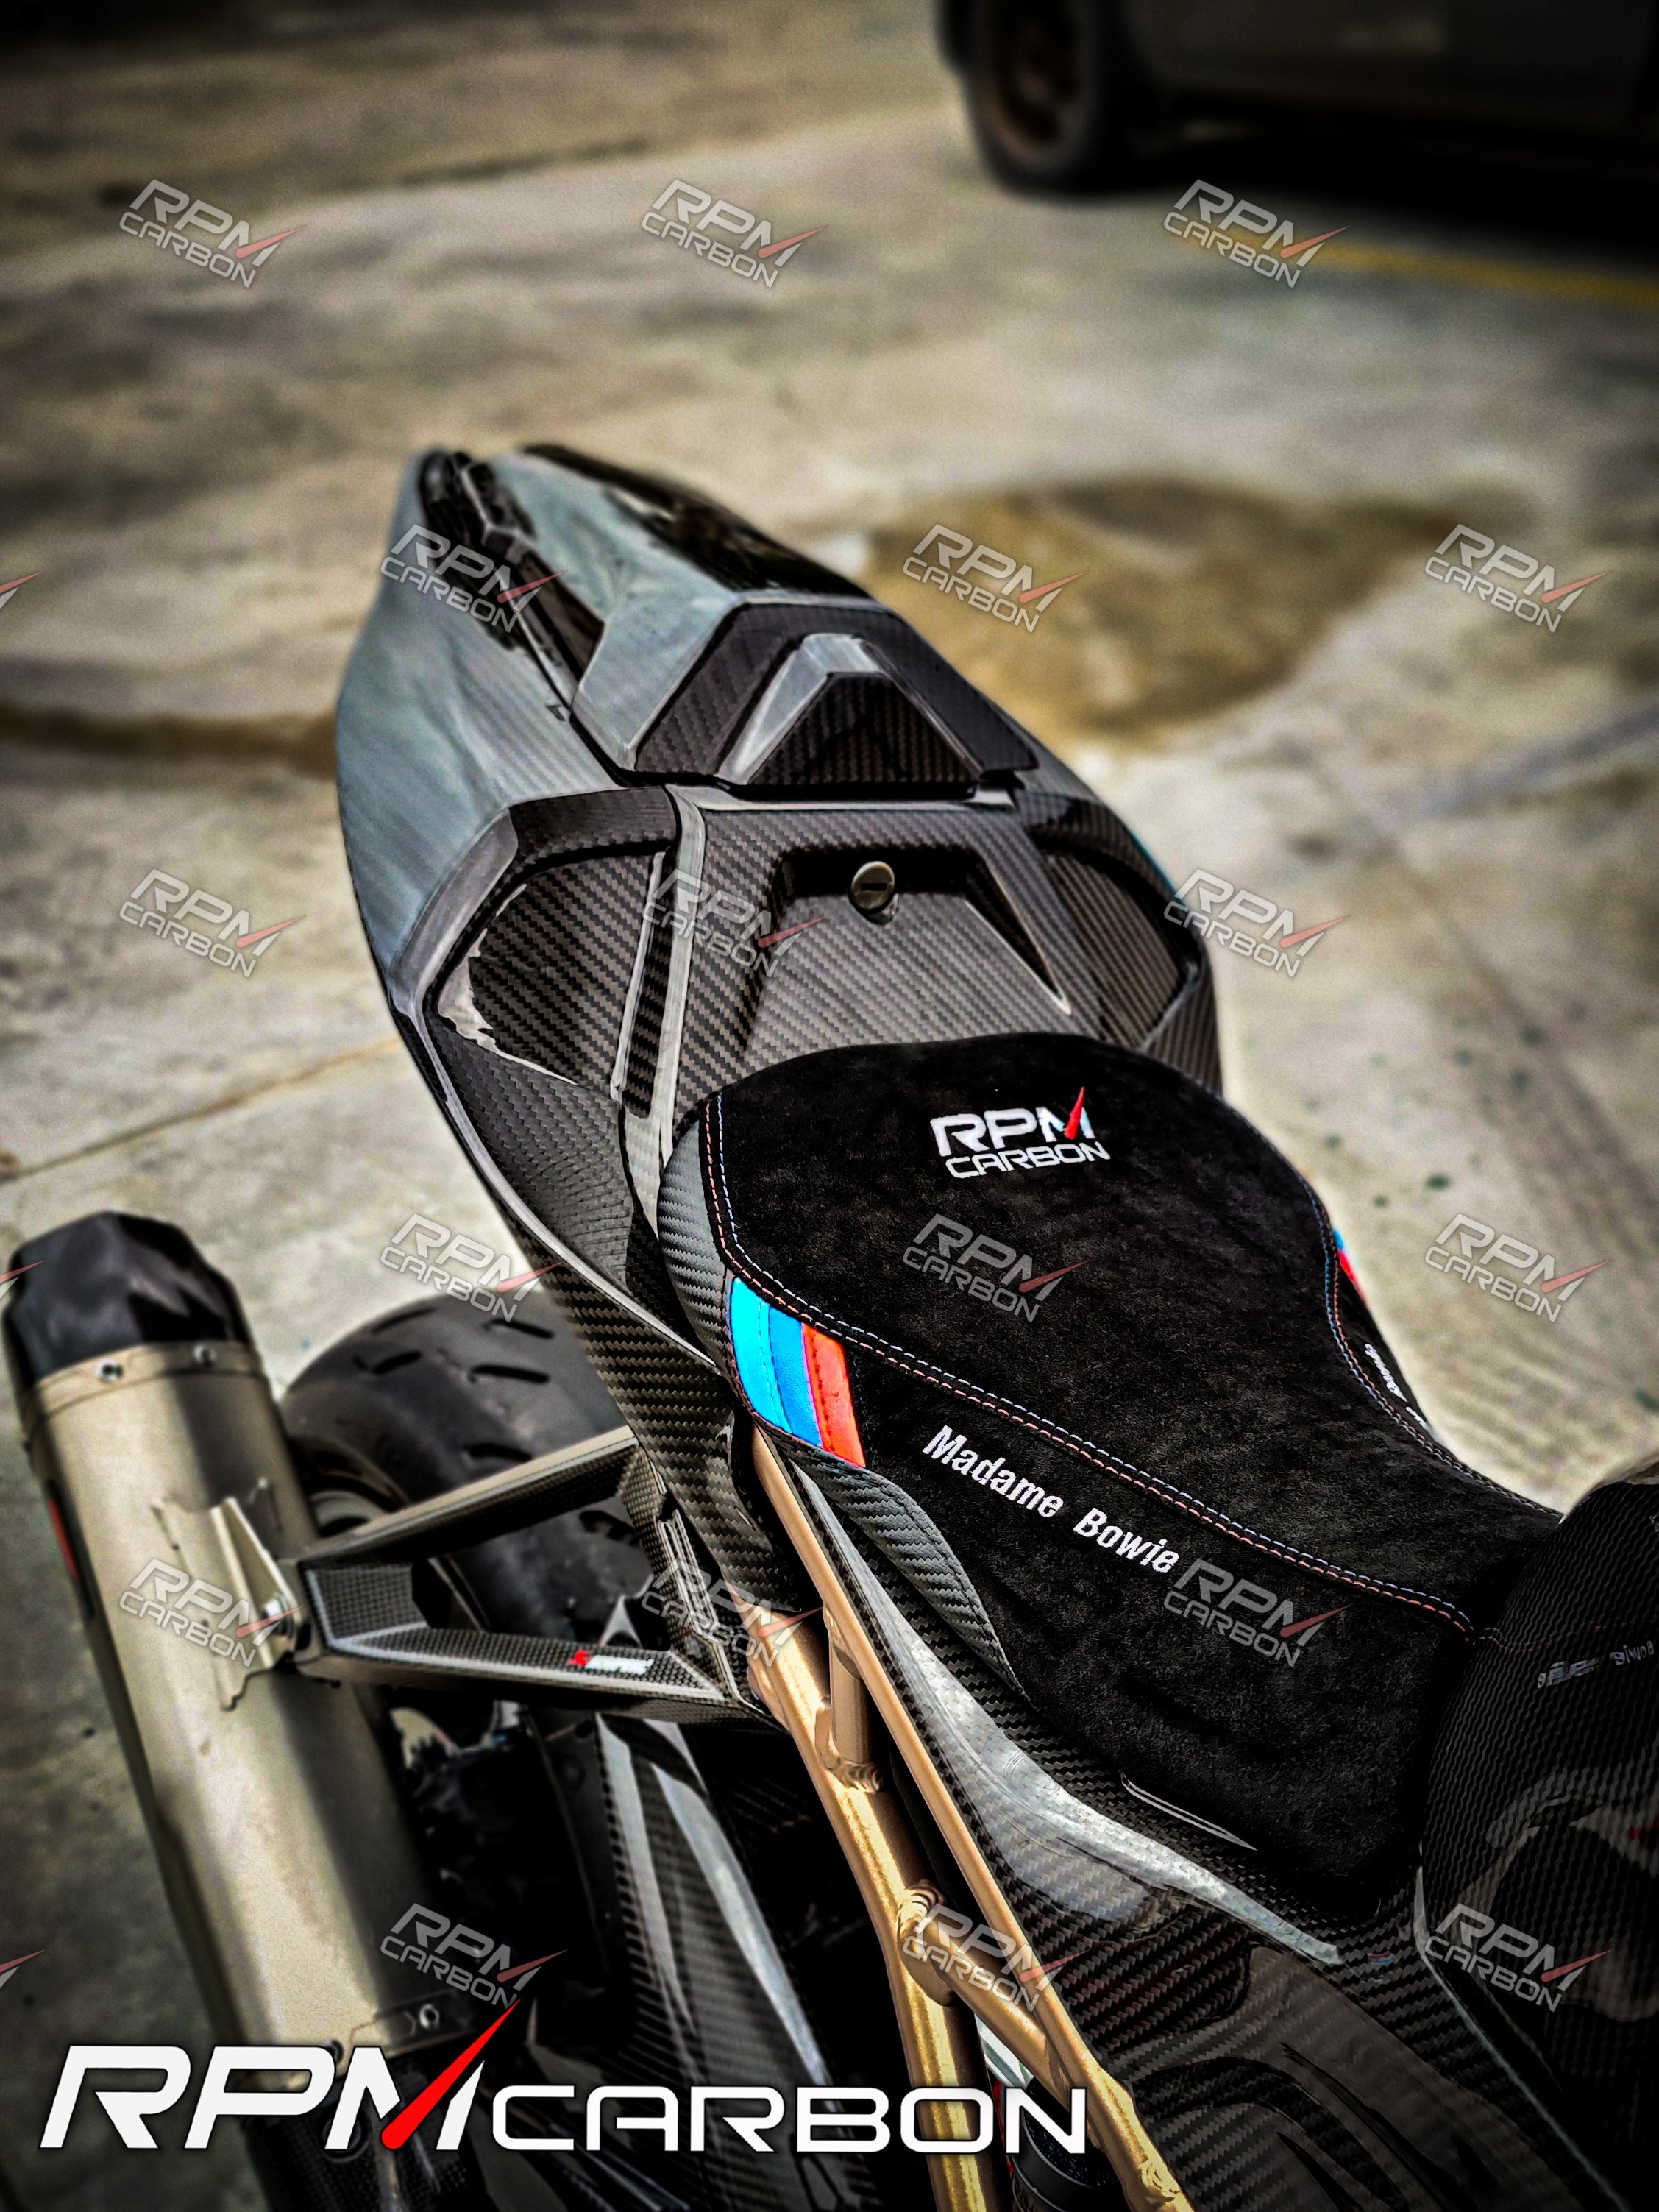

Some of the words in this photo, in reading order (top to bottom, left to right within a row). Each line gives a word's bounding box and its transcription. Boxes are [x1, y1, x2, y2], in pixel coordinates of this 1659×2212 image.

[930, 1087, 1095, 1156] RPM
[945, 1141, 1111, 1178] CARBON
[923, 1425, 1064, 1518] Madame
[1073, 1508, 1179, 1573] Bowie
